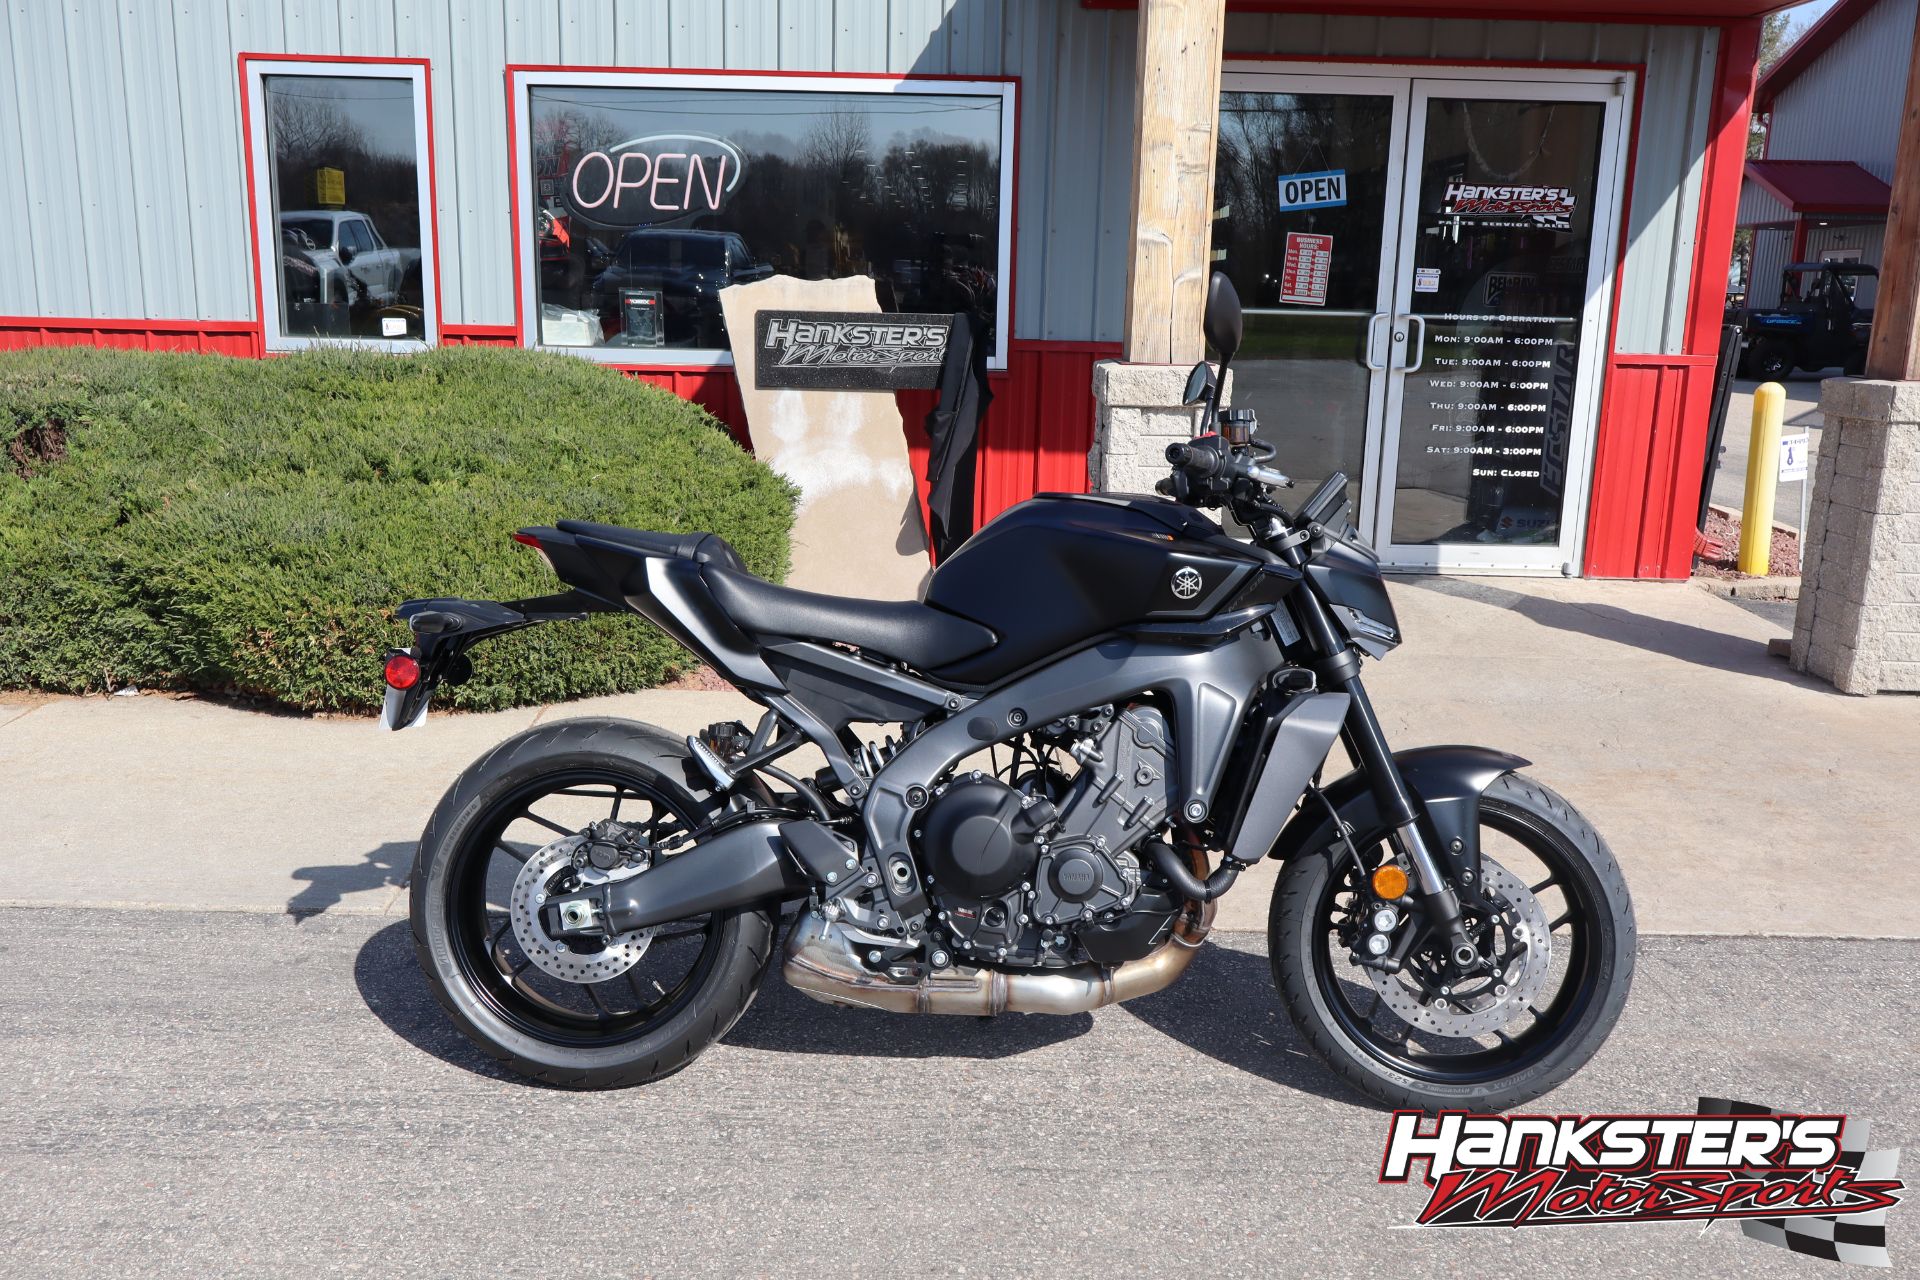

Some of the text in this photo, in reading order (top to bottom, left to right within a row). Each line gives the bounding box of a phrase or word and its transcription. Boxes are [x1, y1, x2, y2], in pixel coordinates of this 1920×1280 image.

[572, 151, 727, 211] OPEN
[1285, 176, 1341, 204] OPEN
[1444, 312, 1479, 321] HOURS
[1499, 314, 1556, 324] OPERATION
[1435, 335, 1460, 343] MON:
[1464, 336, 1504, 344] 9:00AM
[1514, 337, 1553, 346] 6:00PM
[776, 343, 947, 372] MotorSport
[1435, 357, 1458, 366] TUE:
[1462, 358, 1501, 367] 9:00AM
[1512, 359, 1551, 368] 6:00PM
[1430, 380, 1456, 388] WED:
[1460, 380, 1499, 389] 9:00AM
[1510, 381, 1549, 390] 6:00PM
[1430, 402, 1454, 410] THU:
[1458, 402, 1497, 411] 9:00AM
[1507, 404, 1546, 412] 6:00PM
[1432, 424, 1452, 433] FRI:
[1456, 425, 1495, 433] 9:00AM
[1505, 426, 1544, 434] 6:00PM
[1427, 446, 1450, 454] SAT:
[1453, 447, 1493, 455] 9:00AM
[1503, 448, 1542, 456] 3:00PM
[1472, 468, 1540, 478] SUN: CLOSED
[1062, 872, 1091, 882] YAMAHA
